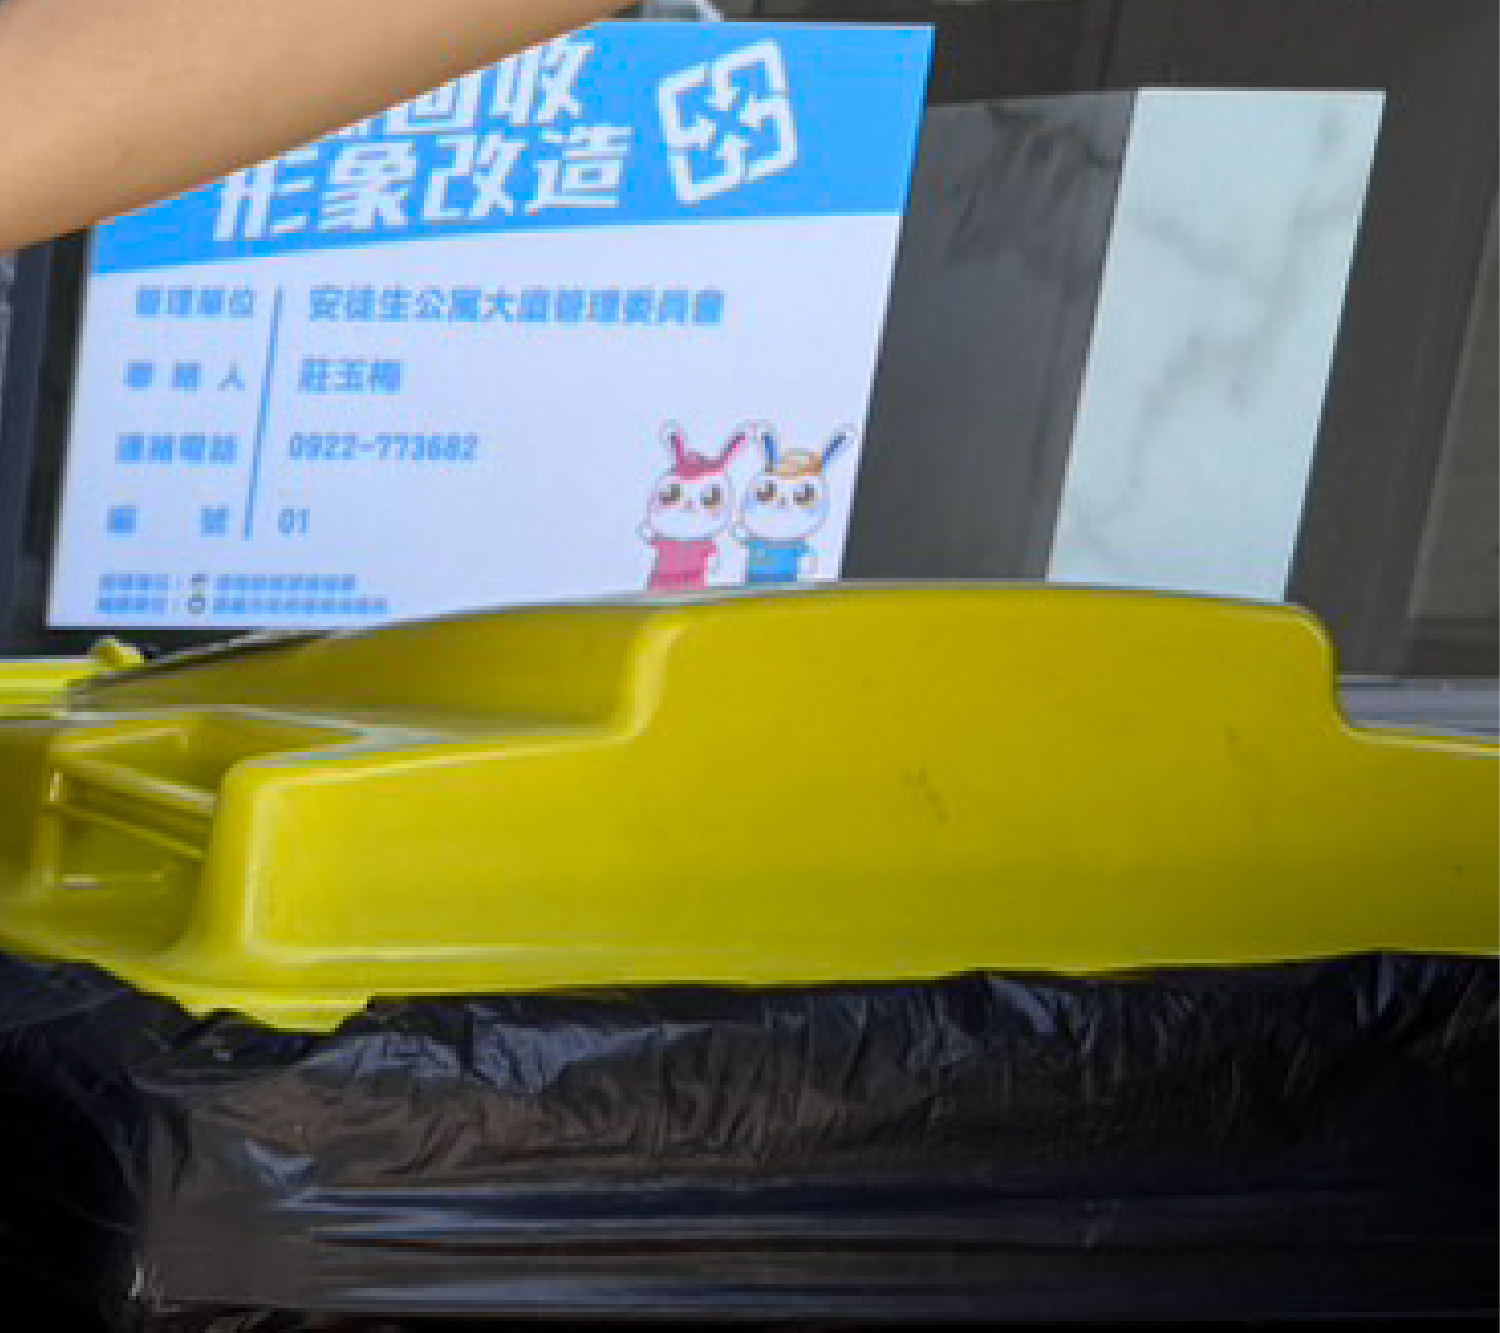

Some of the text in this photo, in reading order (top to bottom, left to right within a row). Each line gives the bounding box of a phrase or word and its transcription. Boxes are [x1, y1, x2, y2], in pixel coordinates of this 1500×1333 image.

[213, 124, 634, 241] 形象改造
[277, 507, 311, 538] 01
